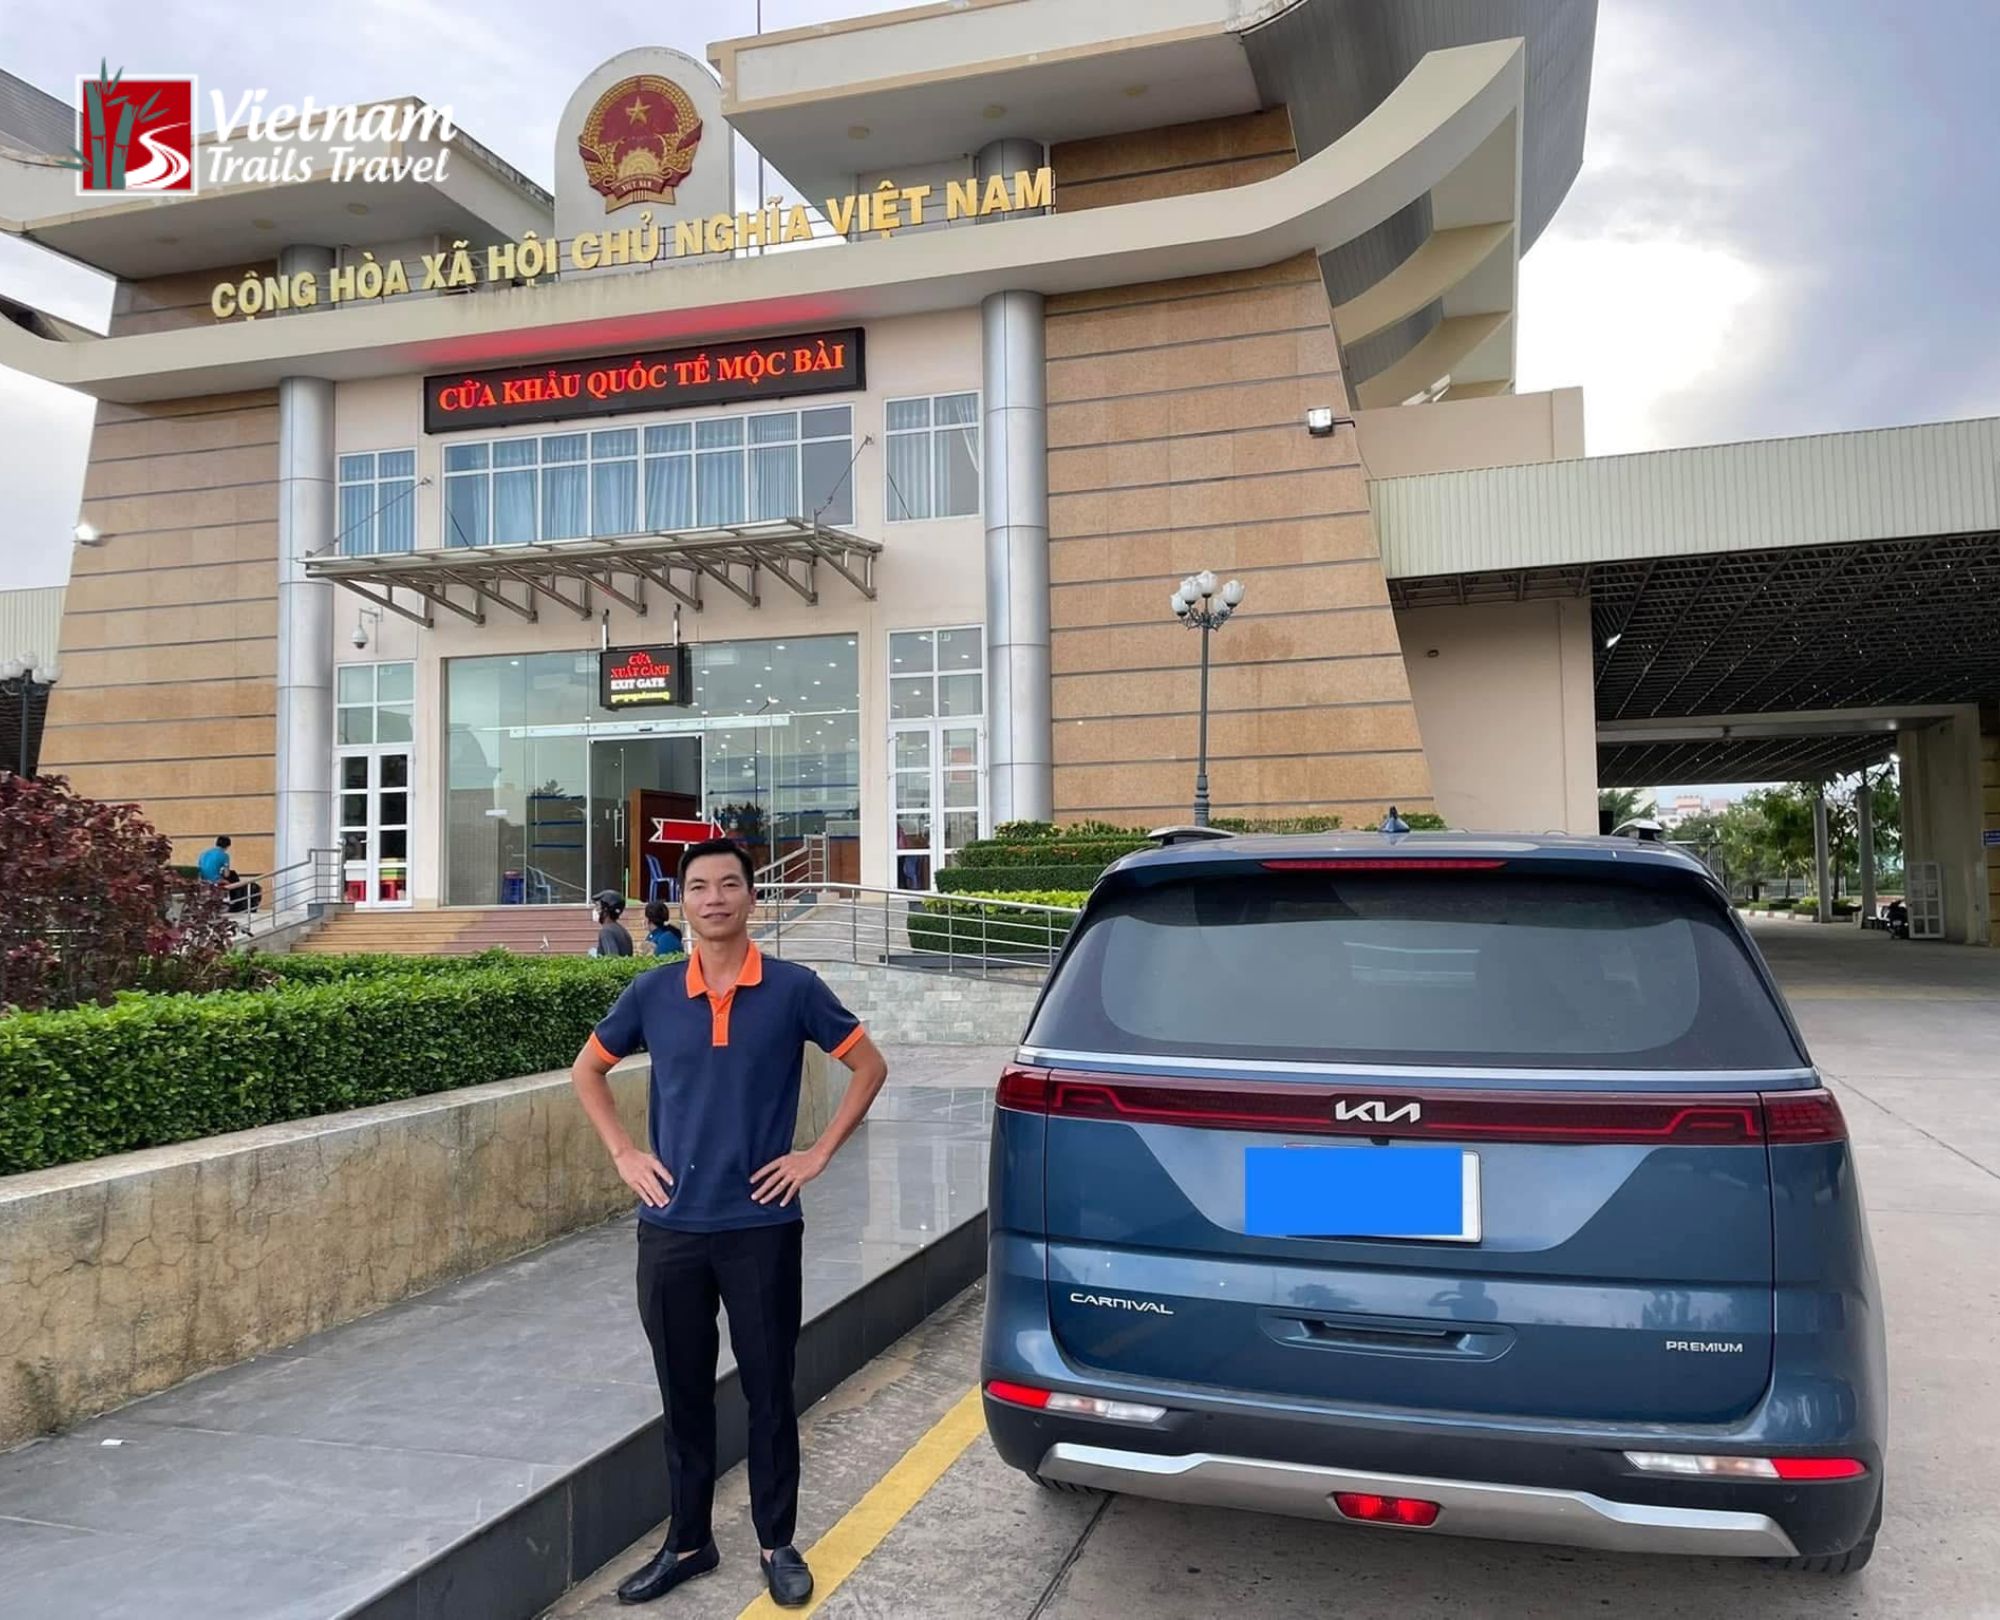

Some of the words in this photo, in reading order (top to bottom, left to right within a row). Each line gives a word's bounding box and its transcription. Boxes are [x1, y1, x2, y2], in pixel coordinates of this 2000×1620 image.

[211, 270, 318, 321] CỘNG
[330, 252, 409, 302] HÒA
[421, 239, 477, 289] XÃ
[488, 230, 559, 287] HỘI
[571, 210, 660, 270] CHỦ
[675, 194, 813, 257] NGHĨA
[826, 180, 931, 240] VIỆT
[946, 166, 1053, 219] NAM
[438, 378, 497, 412] CỬA
[502, 369, 581, 405] KHẨU
[586, 360, 667, 399] QUỐC
[674, 353, 711, 386] TẾ
[717, 349, 786, 385] MỘC
[793, 340, 845, 374] BÀI
[610, 679, 636, 691] EXIT
[636, 677, 666, 689] GATE
[1070, 1292, 1175, 1315] CARNIVAL
[1665, 1340, 1744, 1353] PREMIUM
